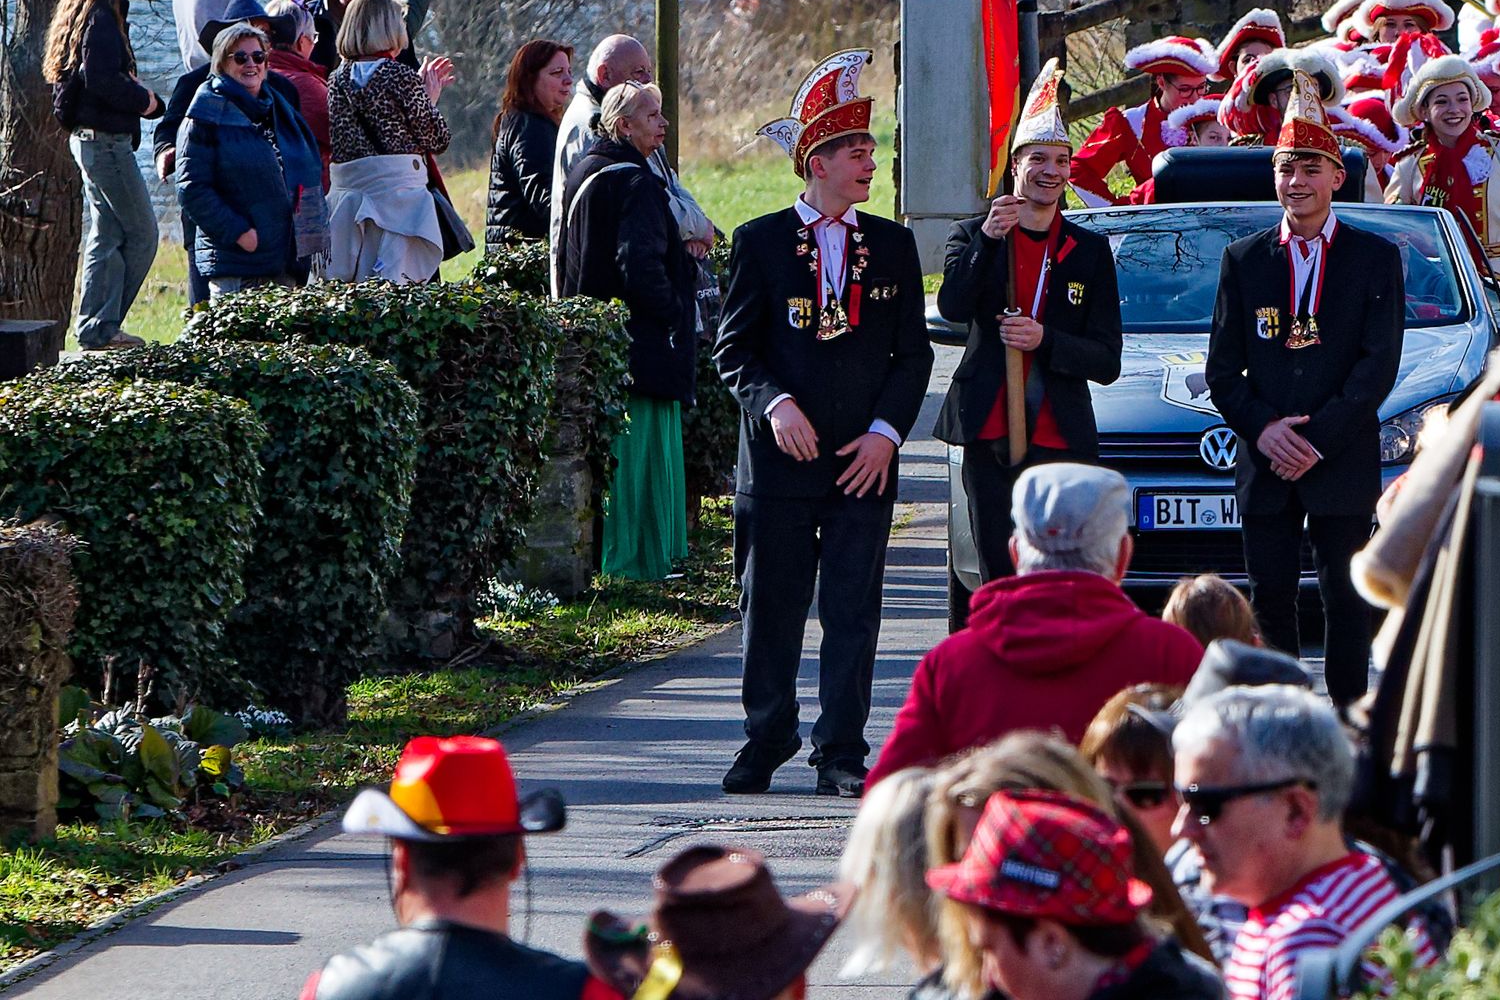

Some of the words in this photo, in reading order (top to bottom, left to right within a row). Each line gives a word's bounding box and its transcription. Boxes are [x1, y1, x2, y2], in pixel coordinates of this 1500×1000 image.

[1425, 185, 1446, 199] UHU
[1068, 282, 1085, 290] UHU
[787, 297, 813, 308] UHU
[1255, 306, 1280, 318] UHU
[1156, 498, 1201, 525] BIT
[1220, 498, 1241, 525] W
